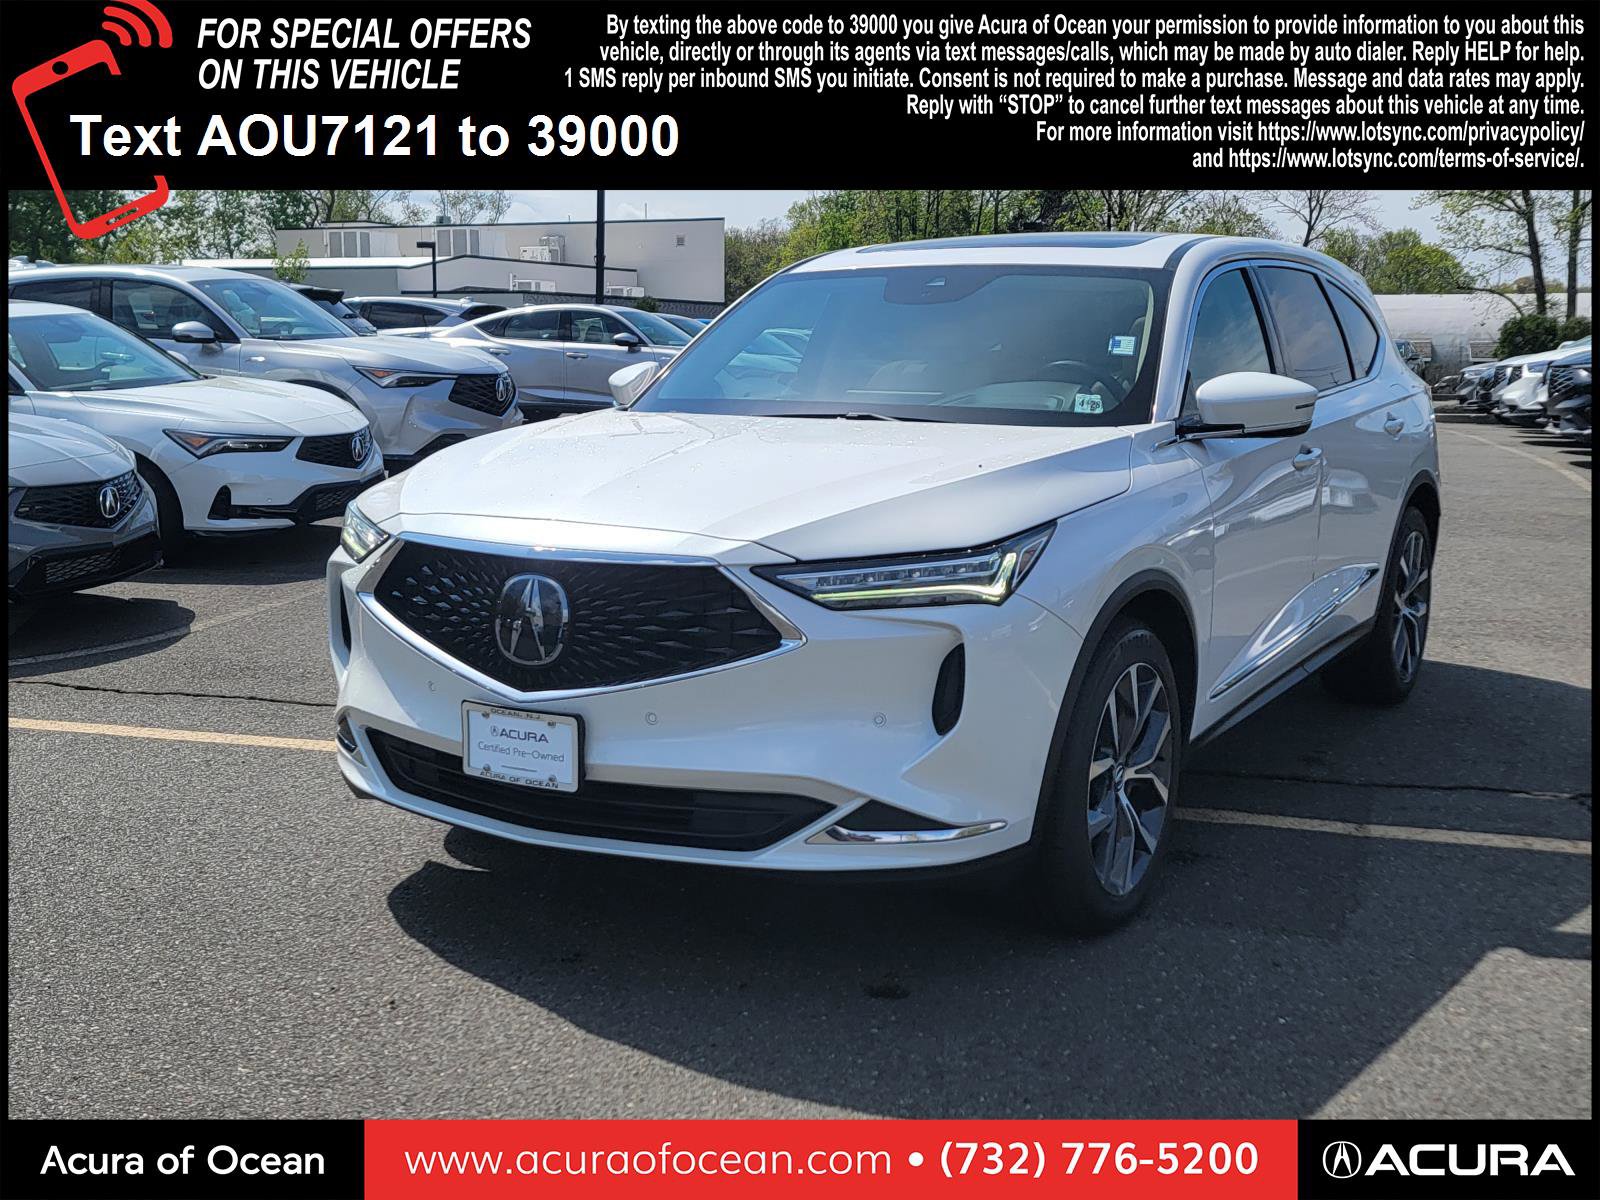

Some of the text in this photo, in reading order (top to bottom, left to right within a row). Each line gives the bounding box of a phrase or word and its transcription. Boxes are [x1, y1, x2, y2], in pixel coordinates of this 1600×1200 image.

[499, 728, 549, 743] ACURA
[478, 740, 565, 762] Certified Pre-Owned
[479, 770, 559, 789] ACURA OF OCEAN
